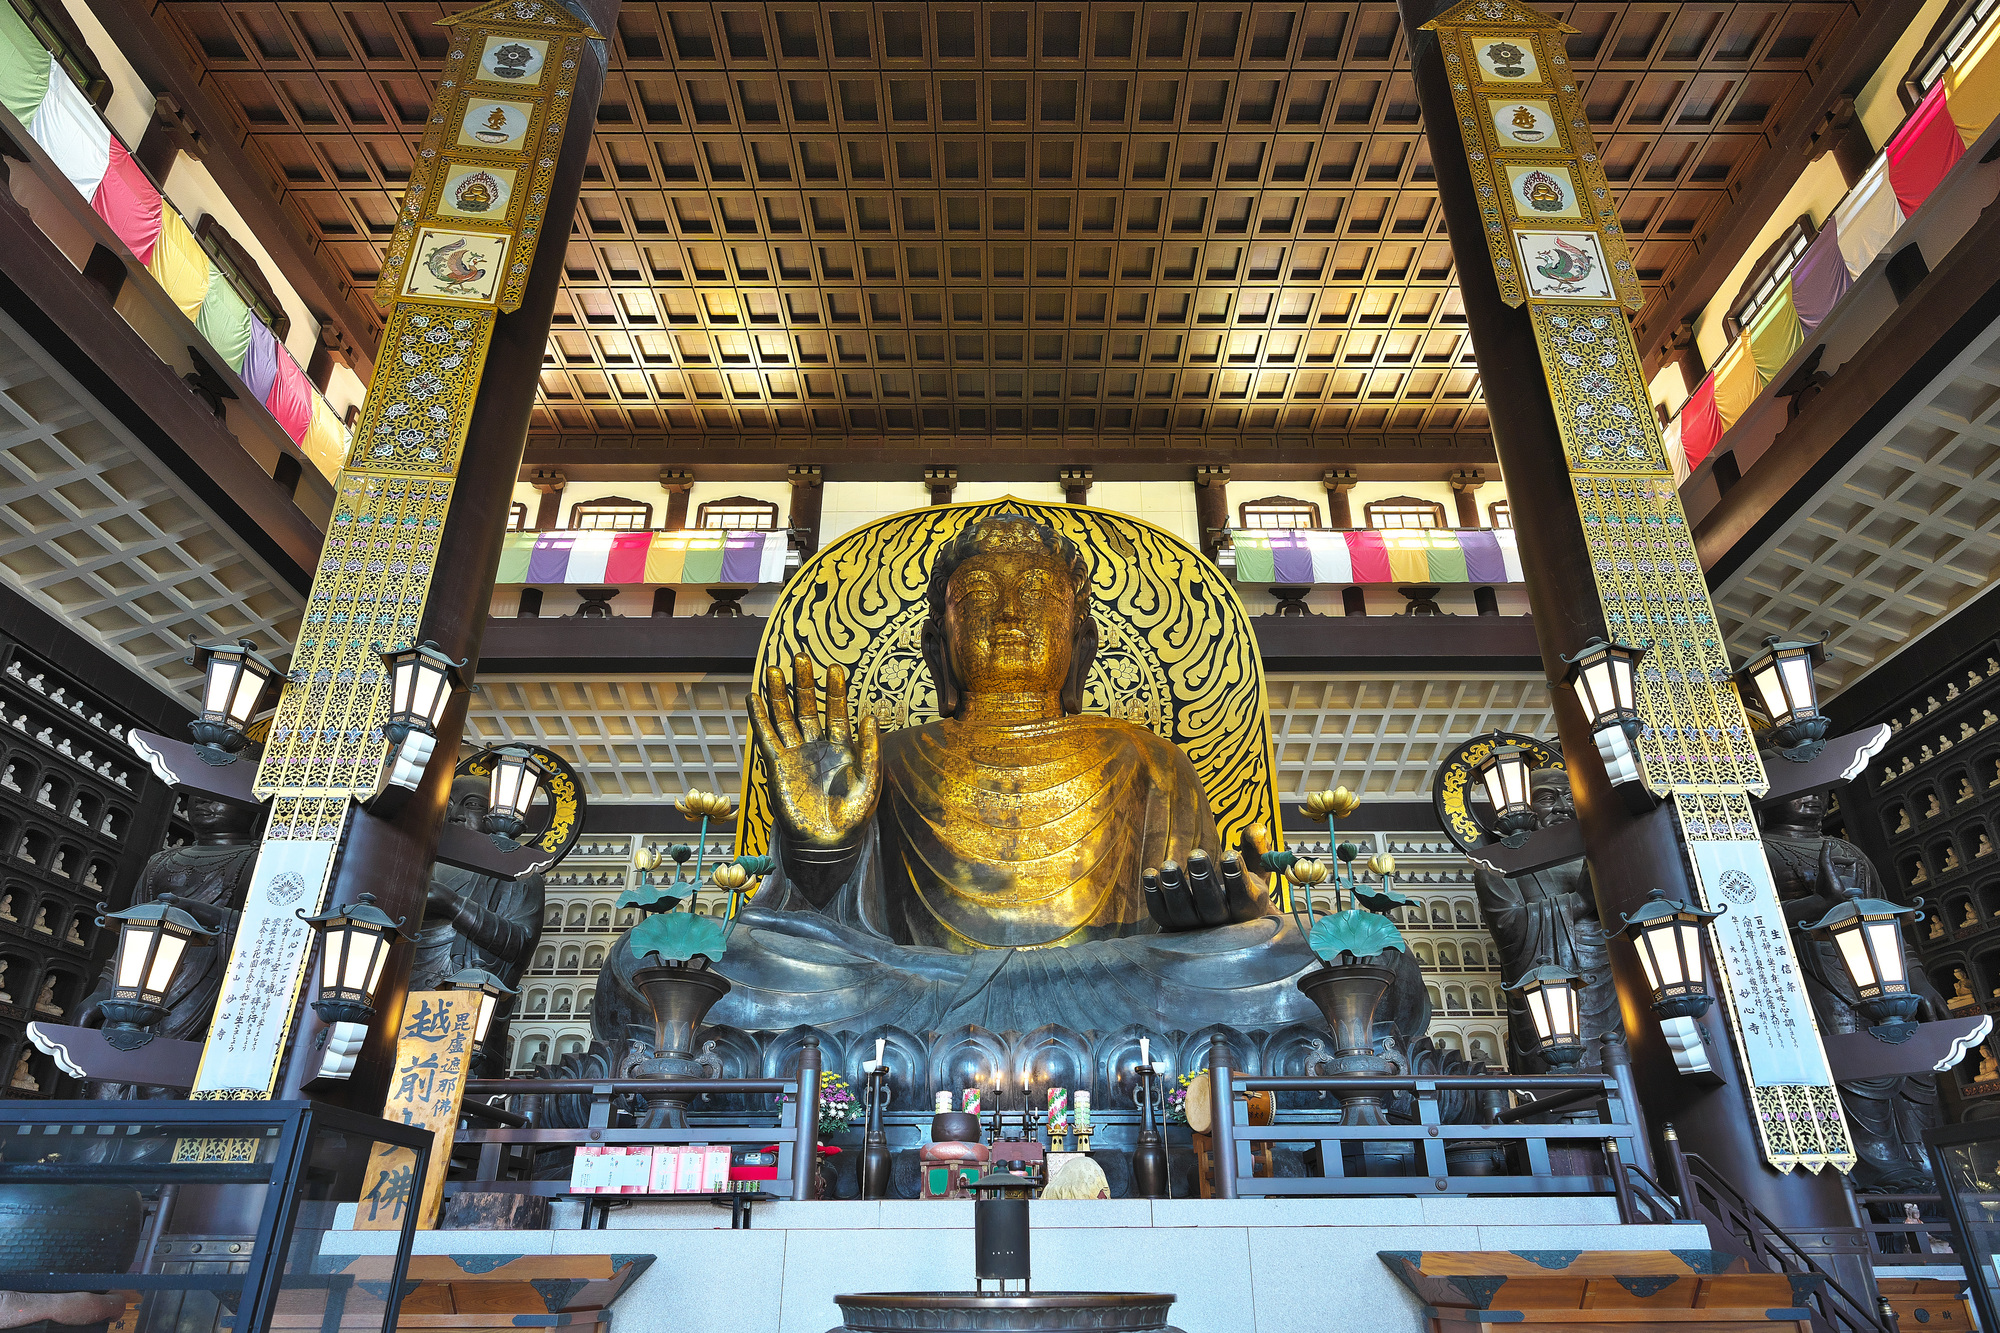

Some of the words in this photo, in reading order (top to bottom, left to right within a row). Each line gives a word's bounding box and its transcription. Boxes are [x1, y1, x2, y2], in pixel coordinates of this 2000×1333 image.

[274, 927, 303, 997] 信心のことば
[1770, 929, 1797, 993] 生活信条
